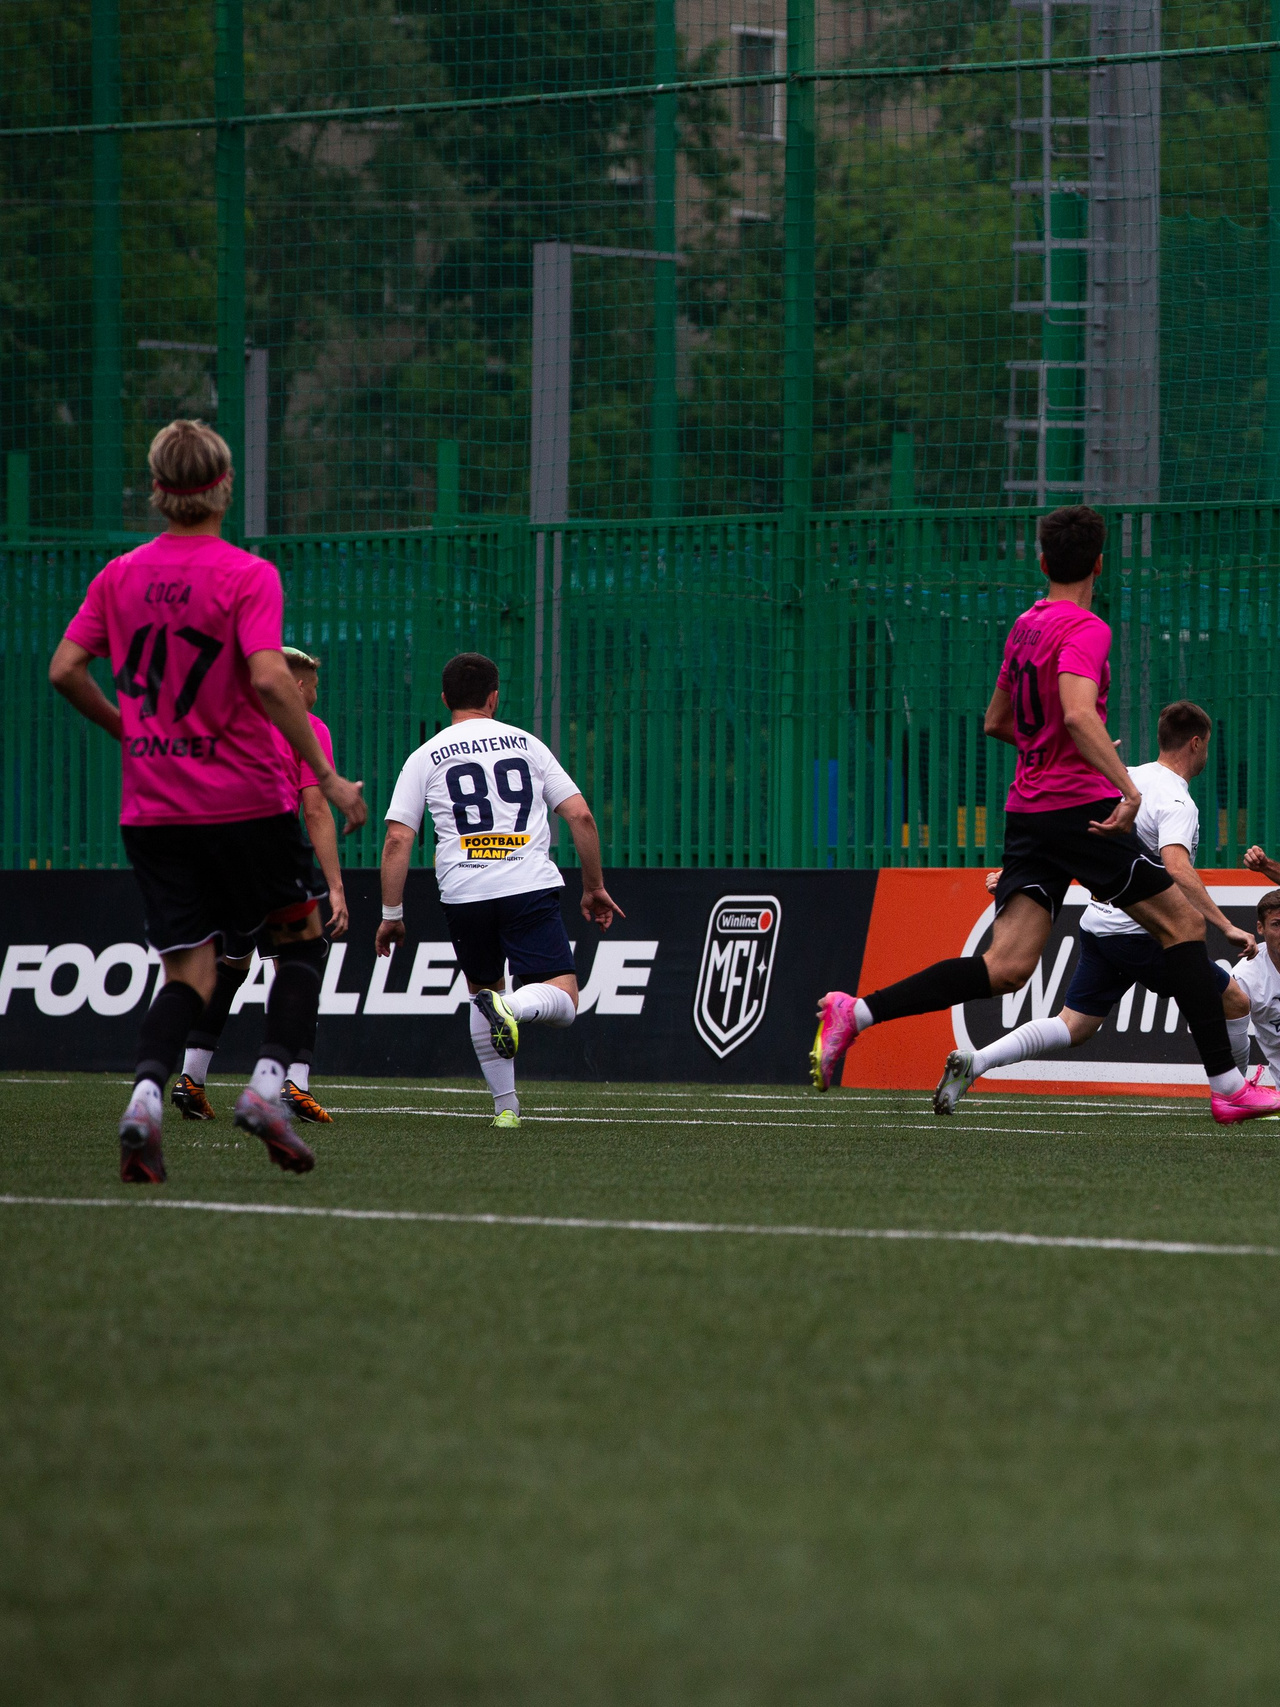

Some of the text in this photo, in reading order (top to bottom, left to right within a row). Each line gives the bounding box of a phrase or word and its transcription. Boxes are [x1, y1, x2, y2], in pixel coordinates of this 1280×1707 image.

[115, 622, 224, 723] 47
[125, 736, 219, 758] ONBET
[431, 735, 528, 766] GORBATENKO
[445, 757, 534, 836] 89
[464, 837, 526, 847] FOOTBALL
[722, 914, 757, 928] Winline
[702, 940, 760, 1044] MFL
